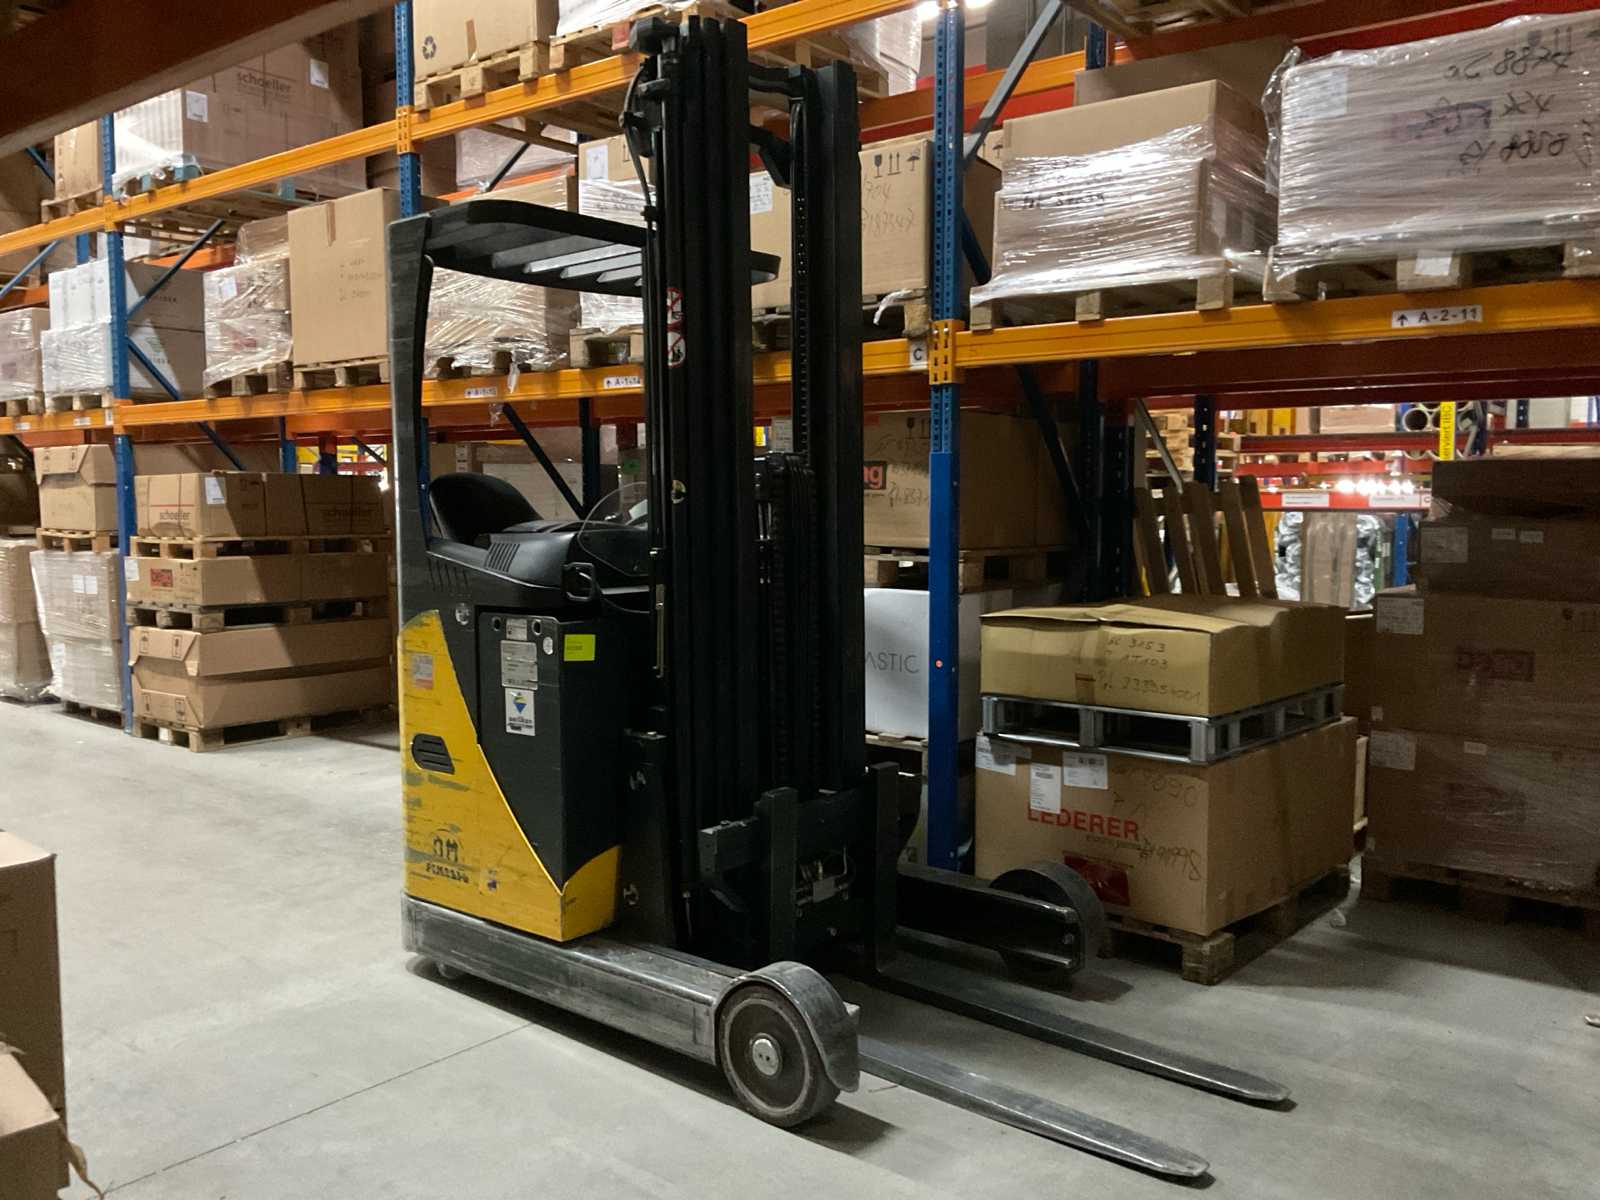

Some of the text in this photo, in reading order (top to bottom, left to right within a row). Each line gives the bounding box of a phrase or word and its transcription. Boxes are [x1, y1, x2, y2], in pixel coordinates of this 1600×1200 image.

[1418, 308, 1477, 323] A-2-11
[912, 347, 923, 361] C
[1027, 807, 1139, 841] LEDERER
